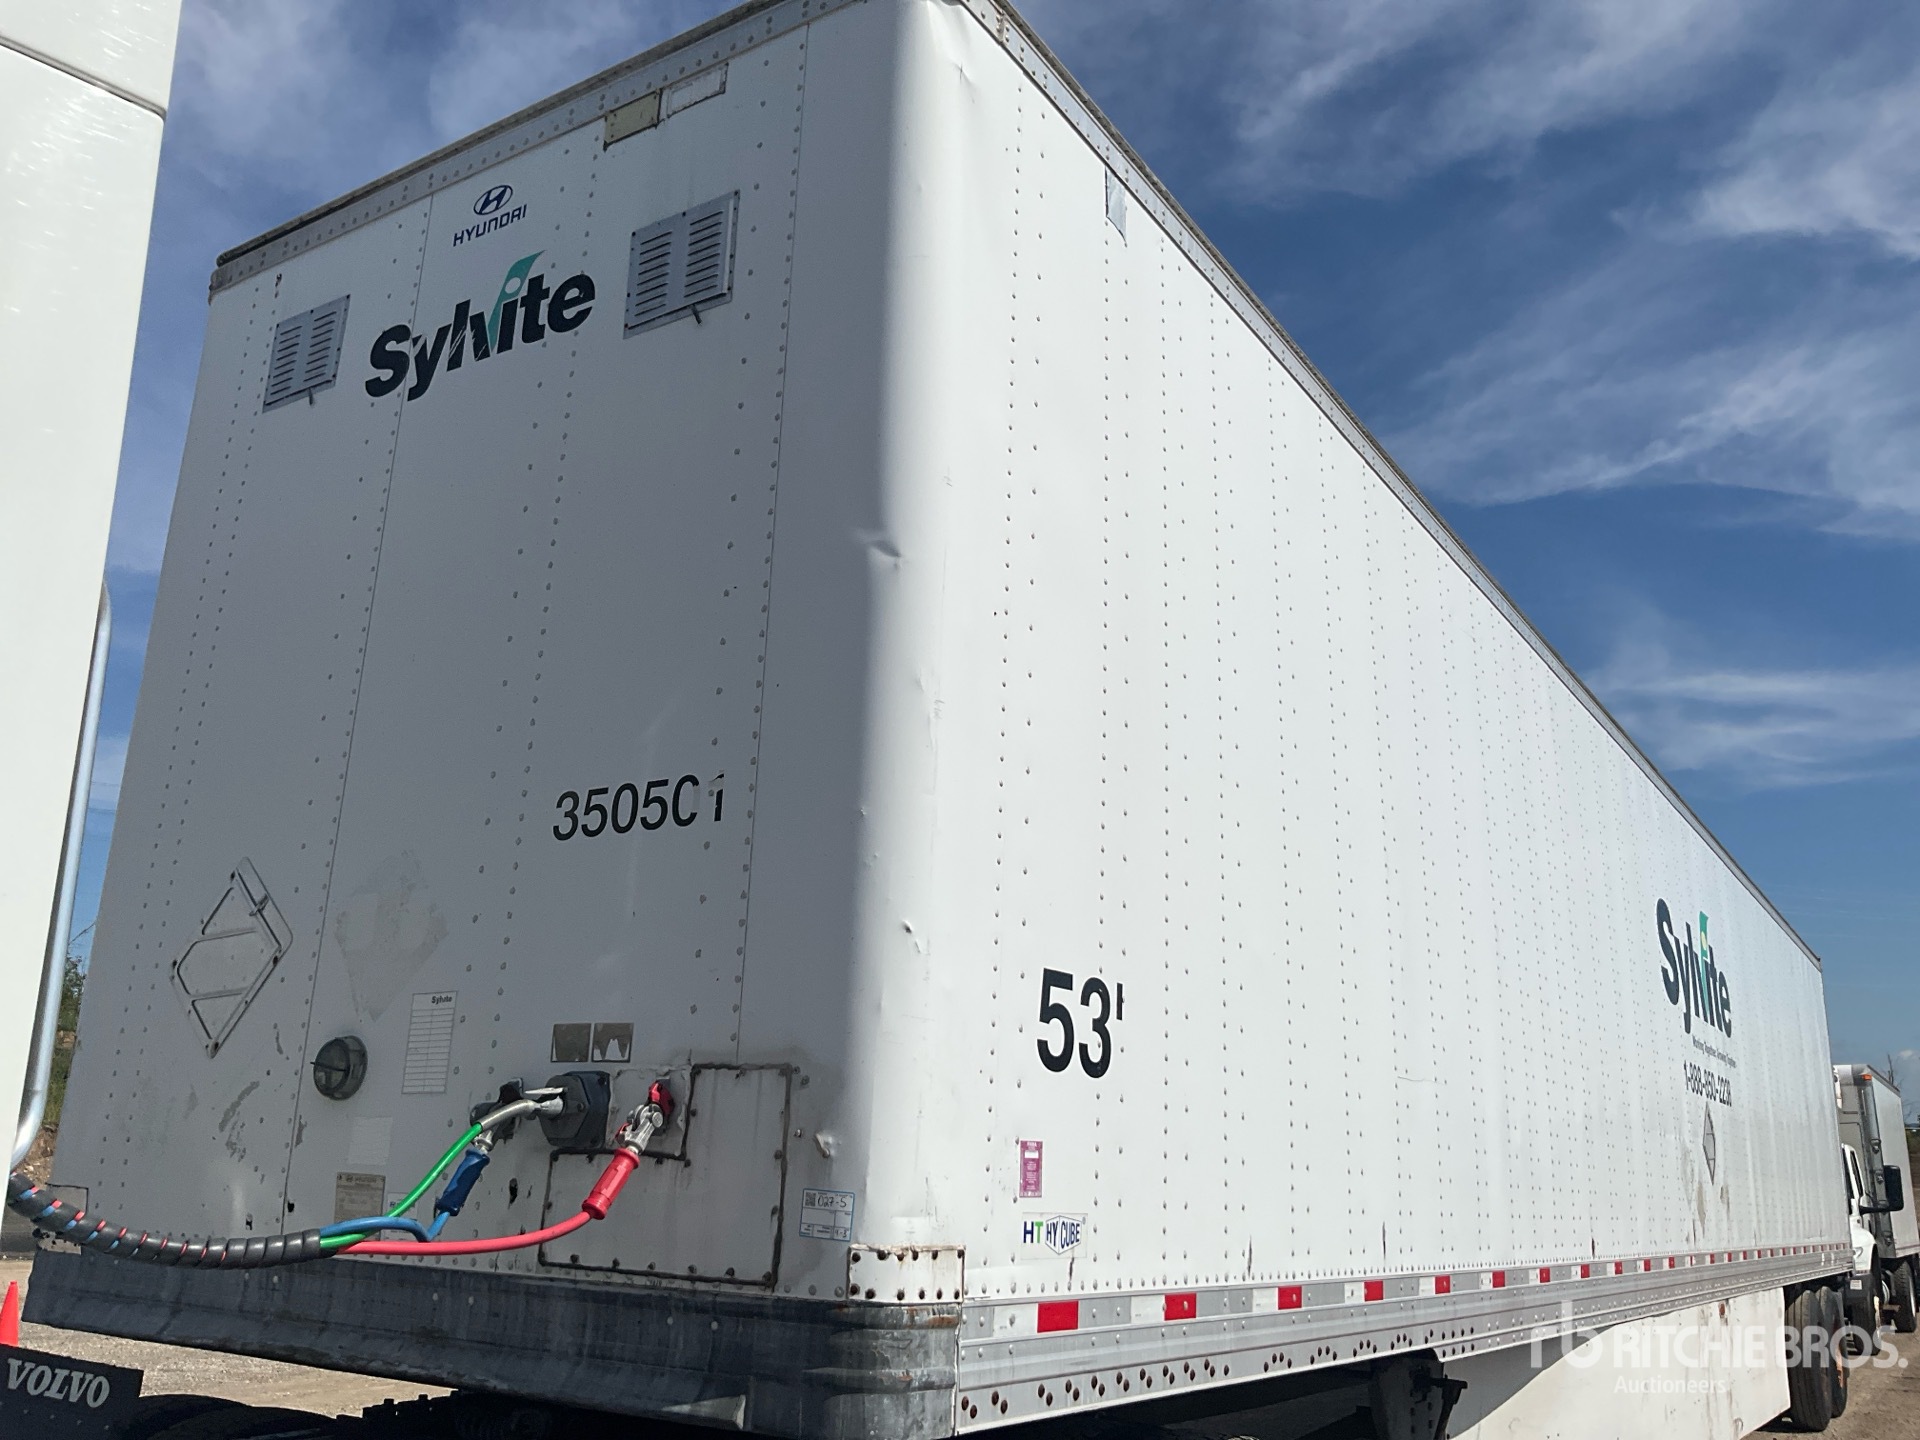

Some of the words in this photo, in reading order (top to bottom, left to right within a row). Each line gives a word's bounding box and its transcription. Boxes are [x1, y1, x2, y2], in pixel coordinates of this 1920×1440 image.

[453, 204, 527, 247] HYUNDAI
[365, 250, 596, 402] Sylvite
[1656, 898, 1732, 1038] Sylvite
[1046, 1221, 1059, 1247] HY
[1060, 1220, 1080, 1249] CUBE
[7, 1357, 110, 1408] VOLVO
